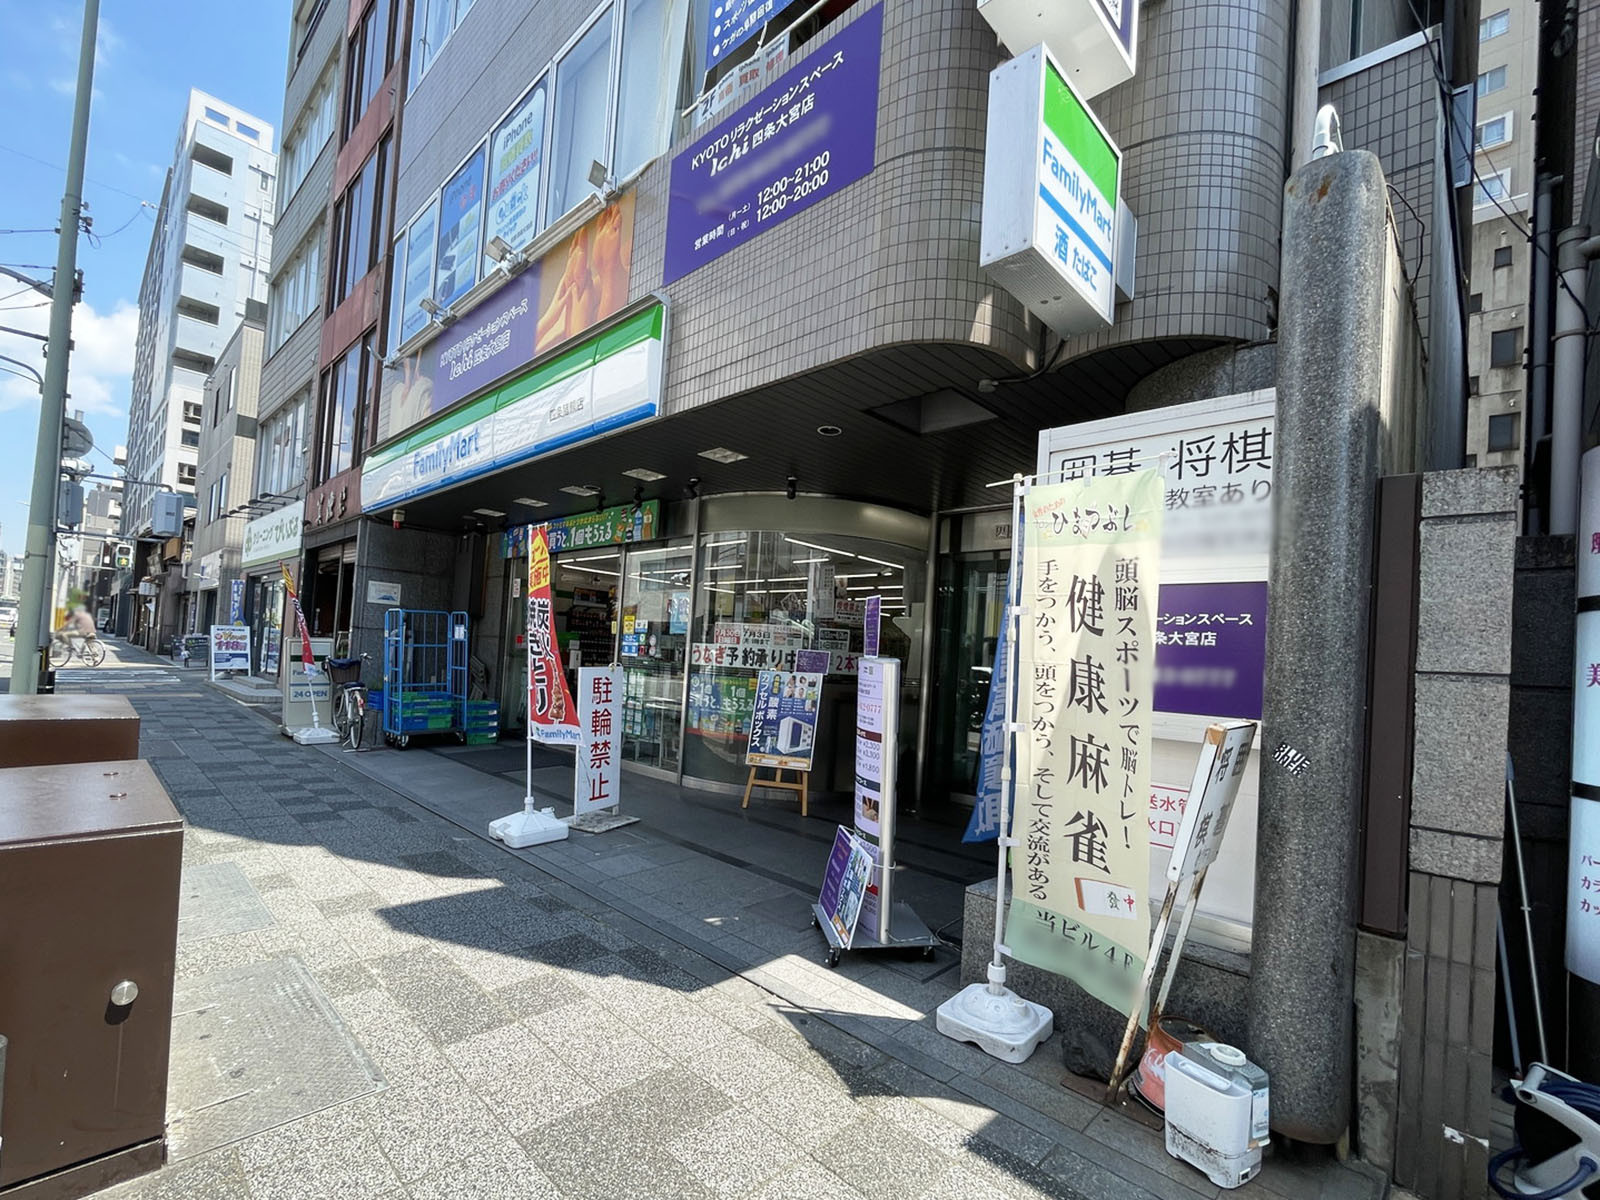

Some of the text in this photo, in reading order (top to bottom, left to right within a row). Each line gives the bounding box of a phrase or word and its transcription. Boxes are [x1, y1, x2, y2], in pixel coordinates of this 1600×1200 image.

[503, 110, 534, 149] iPhone
[752, 93, 815, 149] 四条大宮店
[1042, 137, 1112, 242] FamilyMart
[694, 223, 725, 251] 営業時間
[1054, 223, 1098, 291] 酒 たばこ
[413, 425, 480, 479] FamilyMart
[1169, 426, 1273, 480] 将棋
[1165, 478, 1272, 511] 教室あり
[1051, 504, 1134, 539] ひまつぶし
[692, 645, 797, 674] うなぎ予約承り中
[835, 654, 859, 673] 2本
[293, 690, 304, 698] 24
[588, 675, 614, 802] 駐輪禁止
[1063, 573, 1112, 875] 健康麻雀
